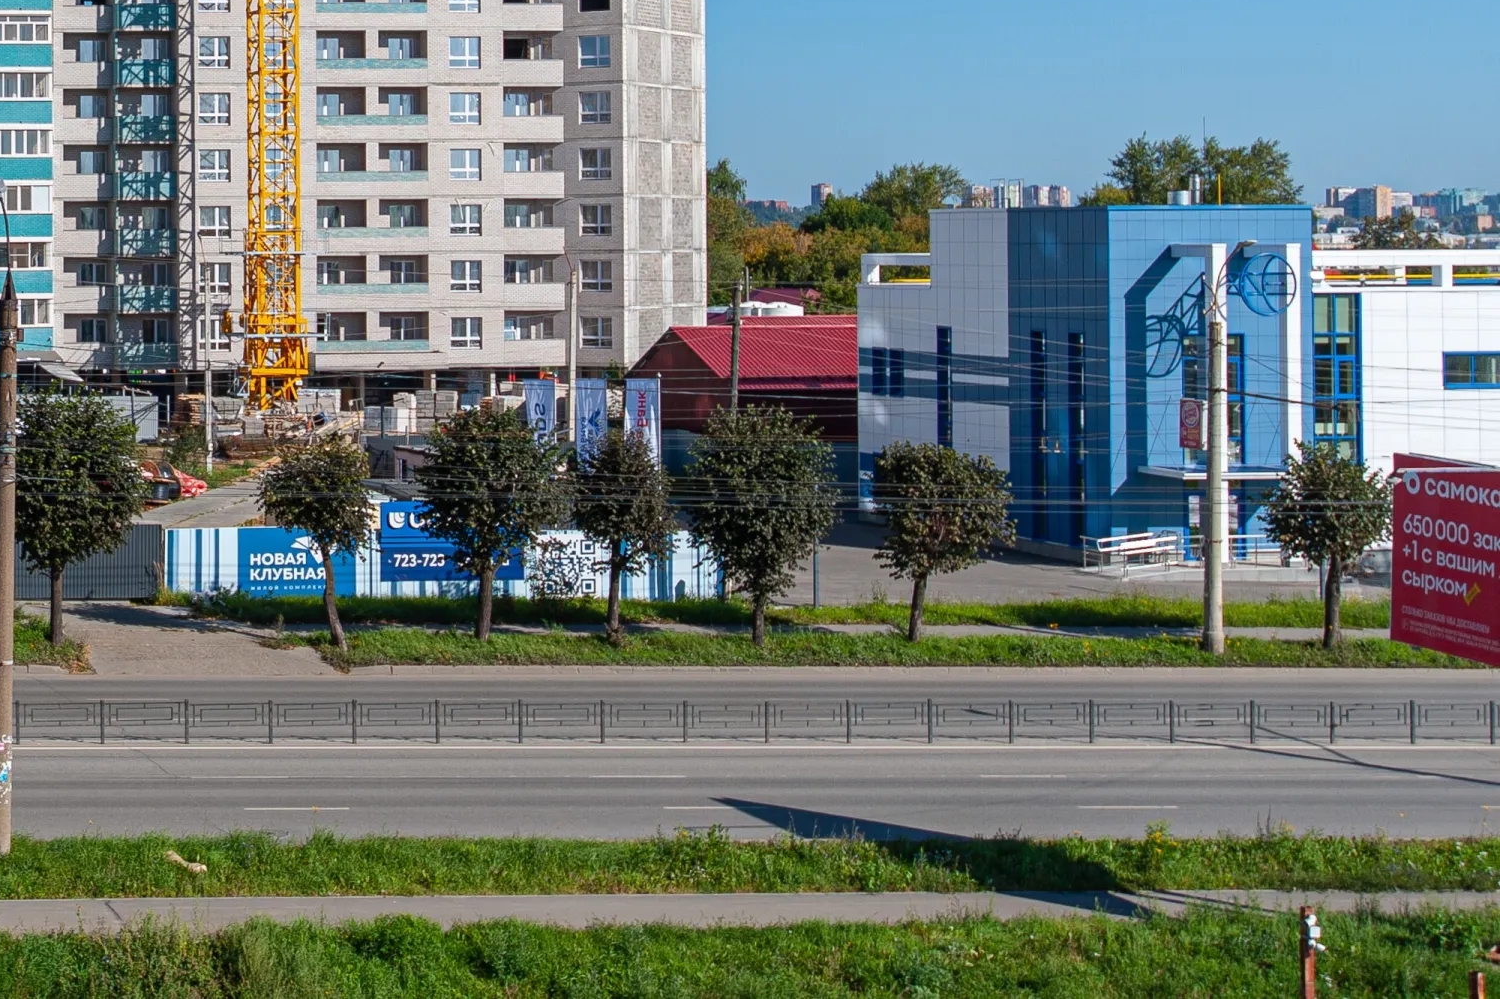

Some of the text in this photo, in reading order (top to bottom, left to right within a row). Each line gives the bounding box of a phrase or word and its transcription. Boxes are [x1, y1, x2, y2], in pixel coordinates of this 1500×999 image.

[1403, 513, 1433, 538] 650
[1435, 519, 1470, 545] 000
[249, 552, 307, 566] НОВАЯ
[393, 553, 446, 568] 723-723
[1402, 539, 1495, 579] +1 с вашим
[249, 567, 327, 581] КЛУБНАЯ
[1402, 569, 1467, 596] сырком
